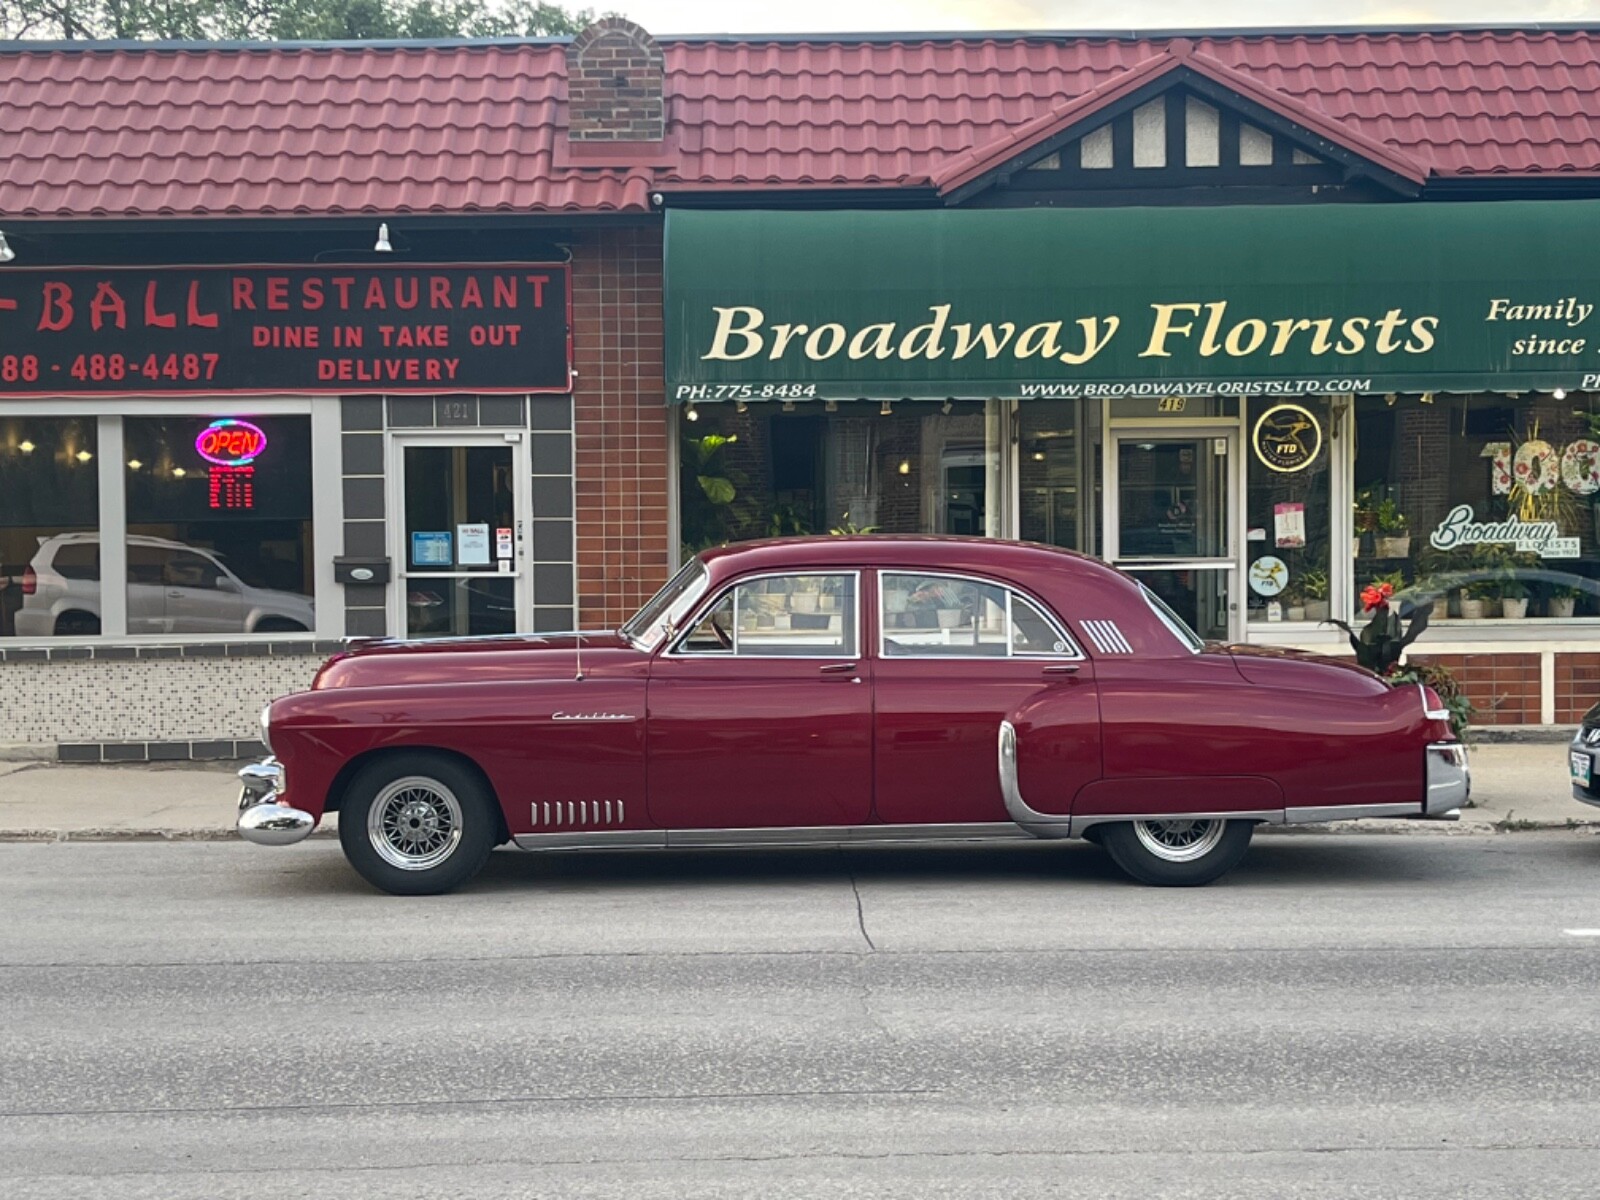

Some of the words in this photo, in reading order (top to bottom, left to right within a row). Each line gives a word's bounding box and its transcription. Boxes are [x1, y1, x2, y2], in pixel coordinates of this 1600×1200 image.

[232, 275, 550, 310] RESTAURANT
[1485, 297, 1594, 327] Family
[252, 325, 320, 348] DINE
[332, 326, 364, 348] IN
[378, 325, 449, 347] TAKE
[469, 325, 522, 346] OUT
[700, 303, 1121, 365] Broadway
[1137, 300, 1440, 359] Florists
[1512, 334, 1586, 355] since
[1, 354, 39, 382] 88
[70, 353, 220, 381] 488-4487
[317, 358, 461, 381] DELIVERY
[675, 383, 818, 400] PH:775-8484
[1020, 378, 1373, 397] WWW.BROADWAYFLORISTSLTD.COM
[443, 402, 469, 419] 421
[1159, 398, 1185, 411] 419
[202, 431, 260, 455] OPEN
[1277, 444, 1297, 453] FTD
[1432, 507, 1558, 551] Broadway
